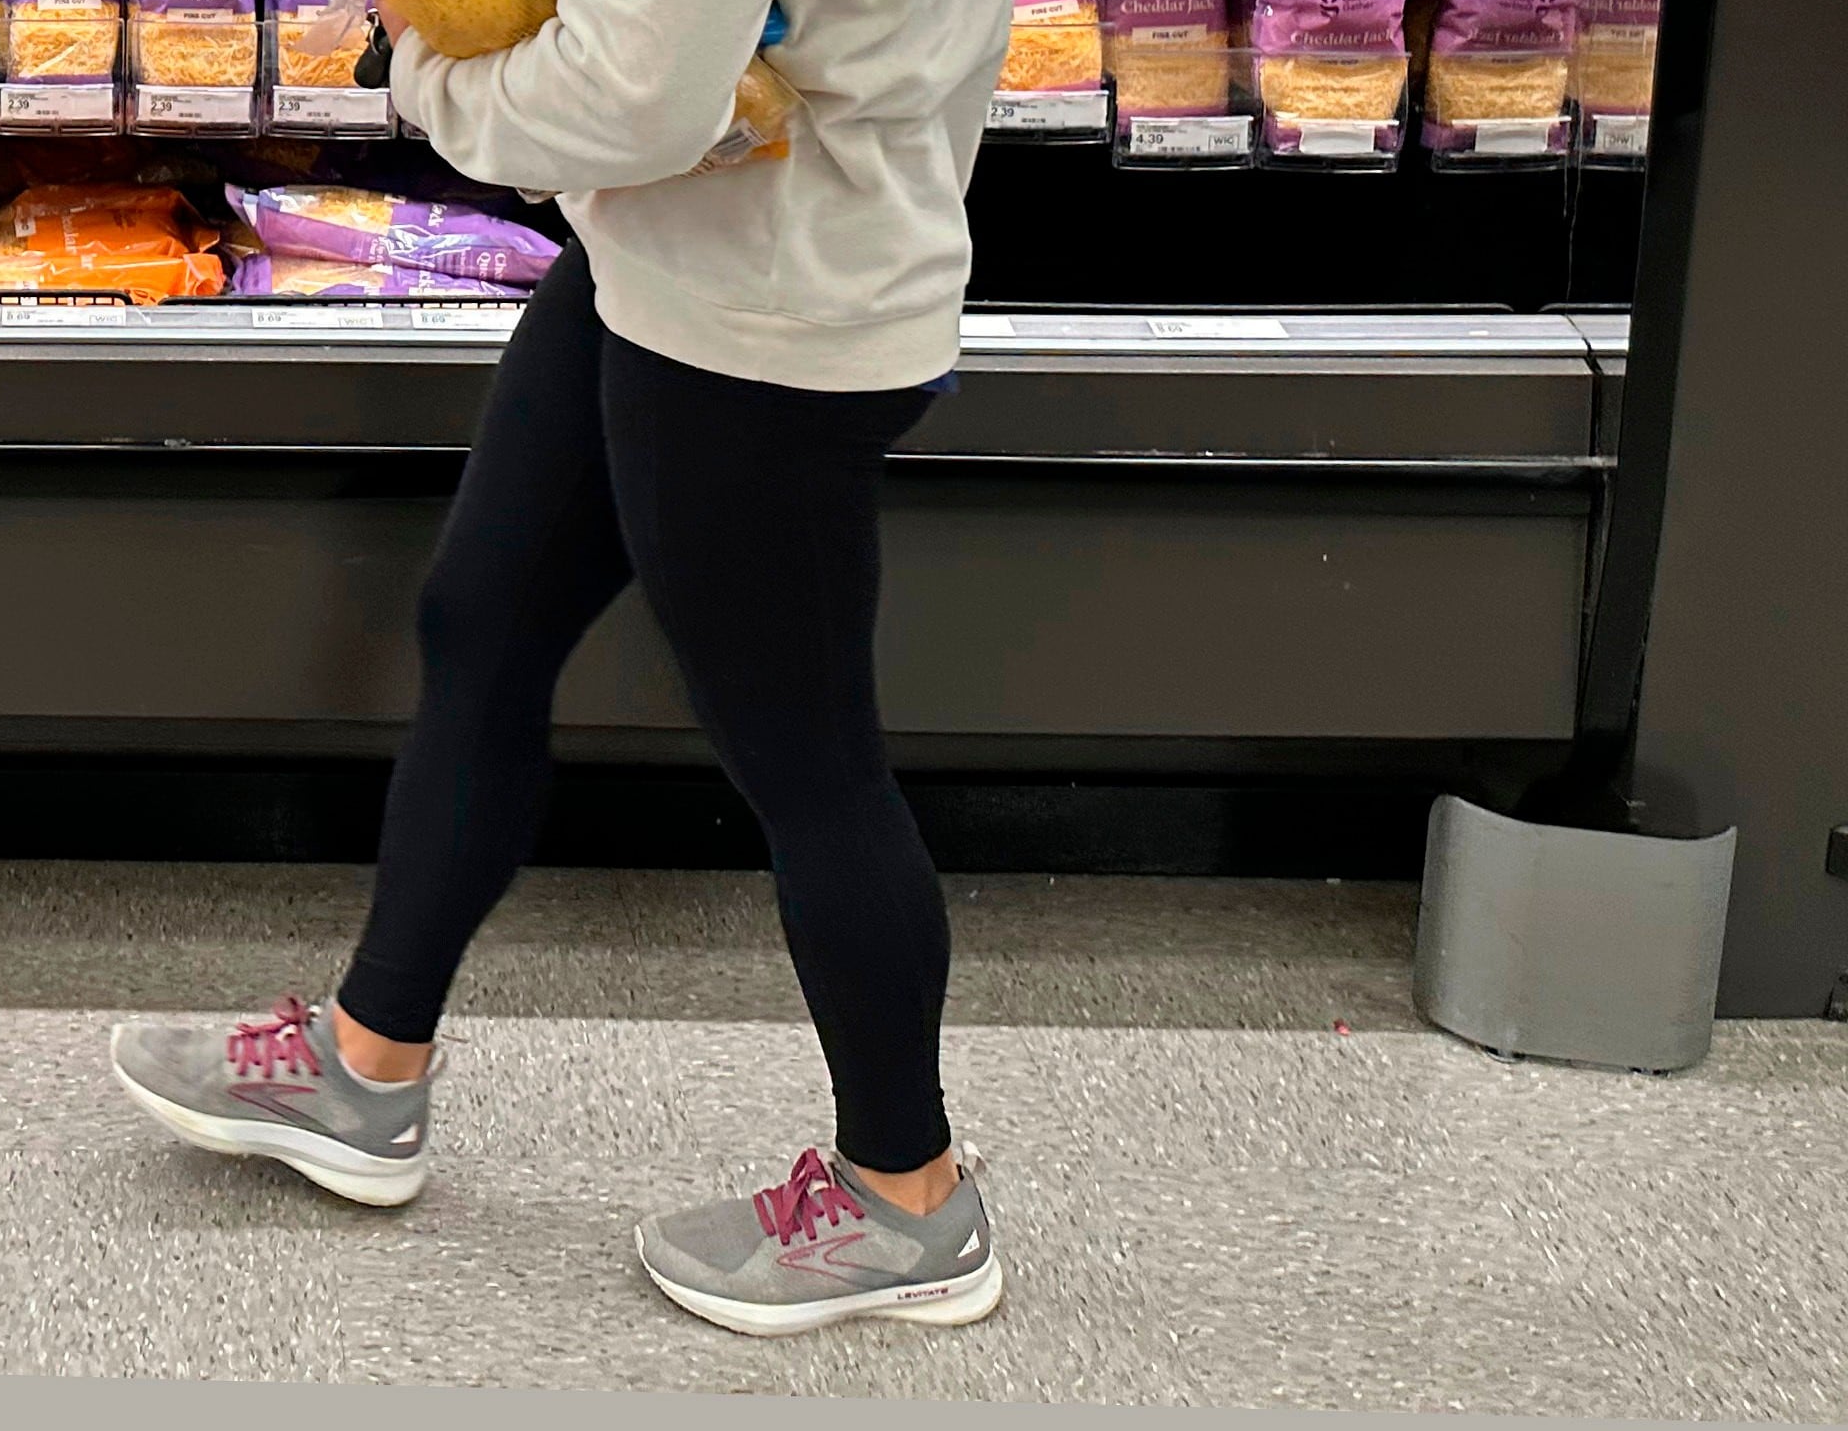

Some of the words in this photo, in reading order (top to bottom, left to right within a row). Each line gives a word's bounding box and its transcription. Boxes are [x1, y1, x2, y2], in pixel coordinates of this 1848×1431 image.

[1290, 31, 1360, 46] Cheddar
[1362, 30, 1394, 46] Jack
[8, 99, 29, 109] 2.39
[1214, 136, 1234, 145] WIC
